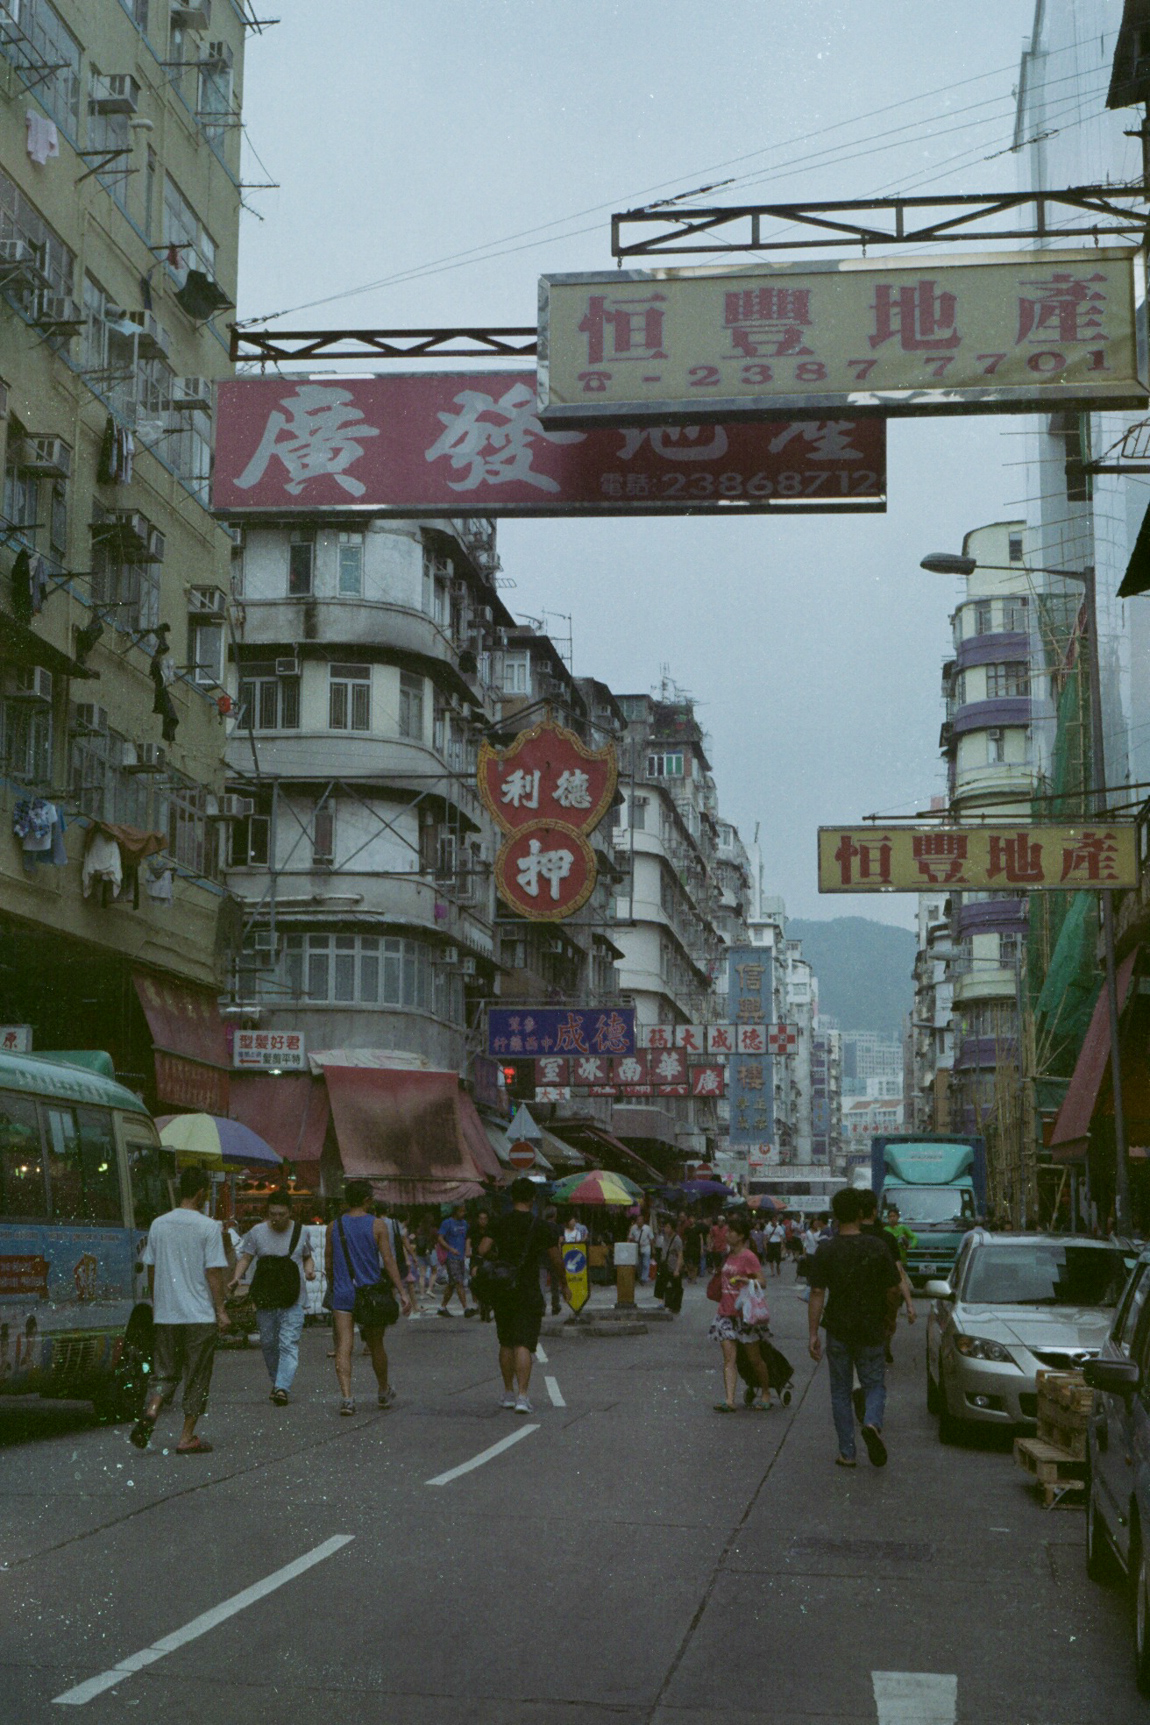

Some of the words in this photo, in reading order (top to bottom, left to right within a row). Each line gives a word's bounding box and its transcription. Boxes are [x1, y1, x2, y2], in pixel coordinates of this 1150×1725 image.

[687, 359, 878, 388] 2387
[924, 350, 1111, 379] 7701
[516, 838, 574, 901] 押
